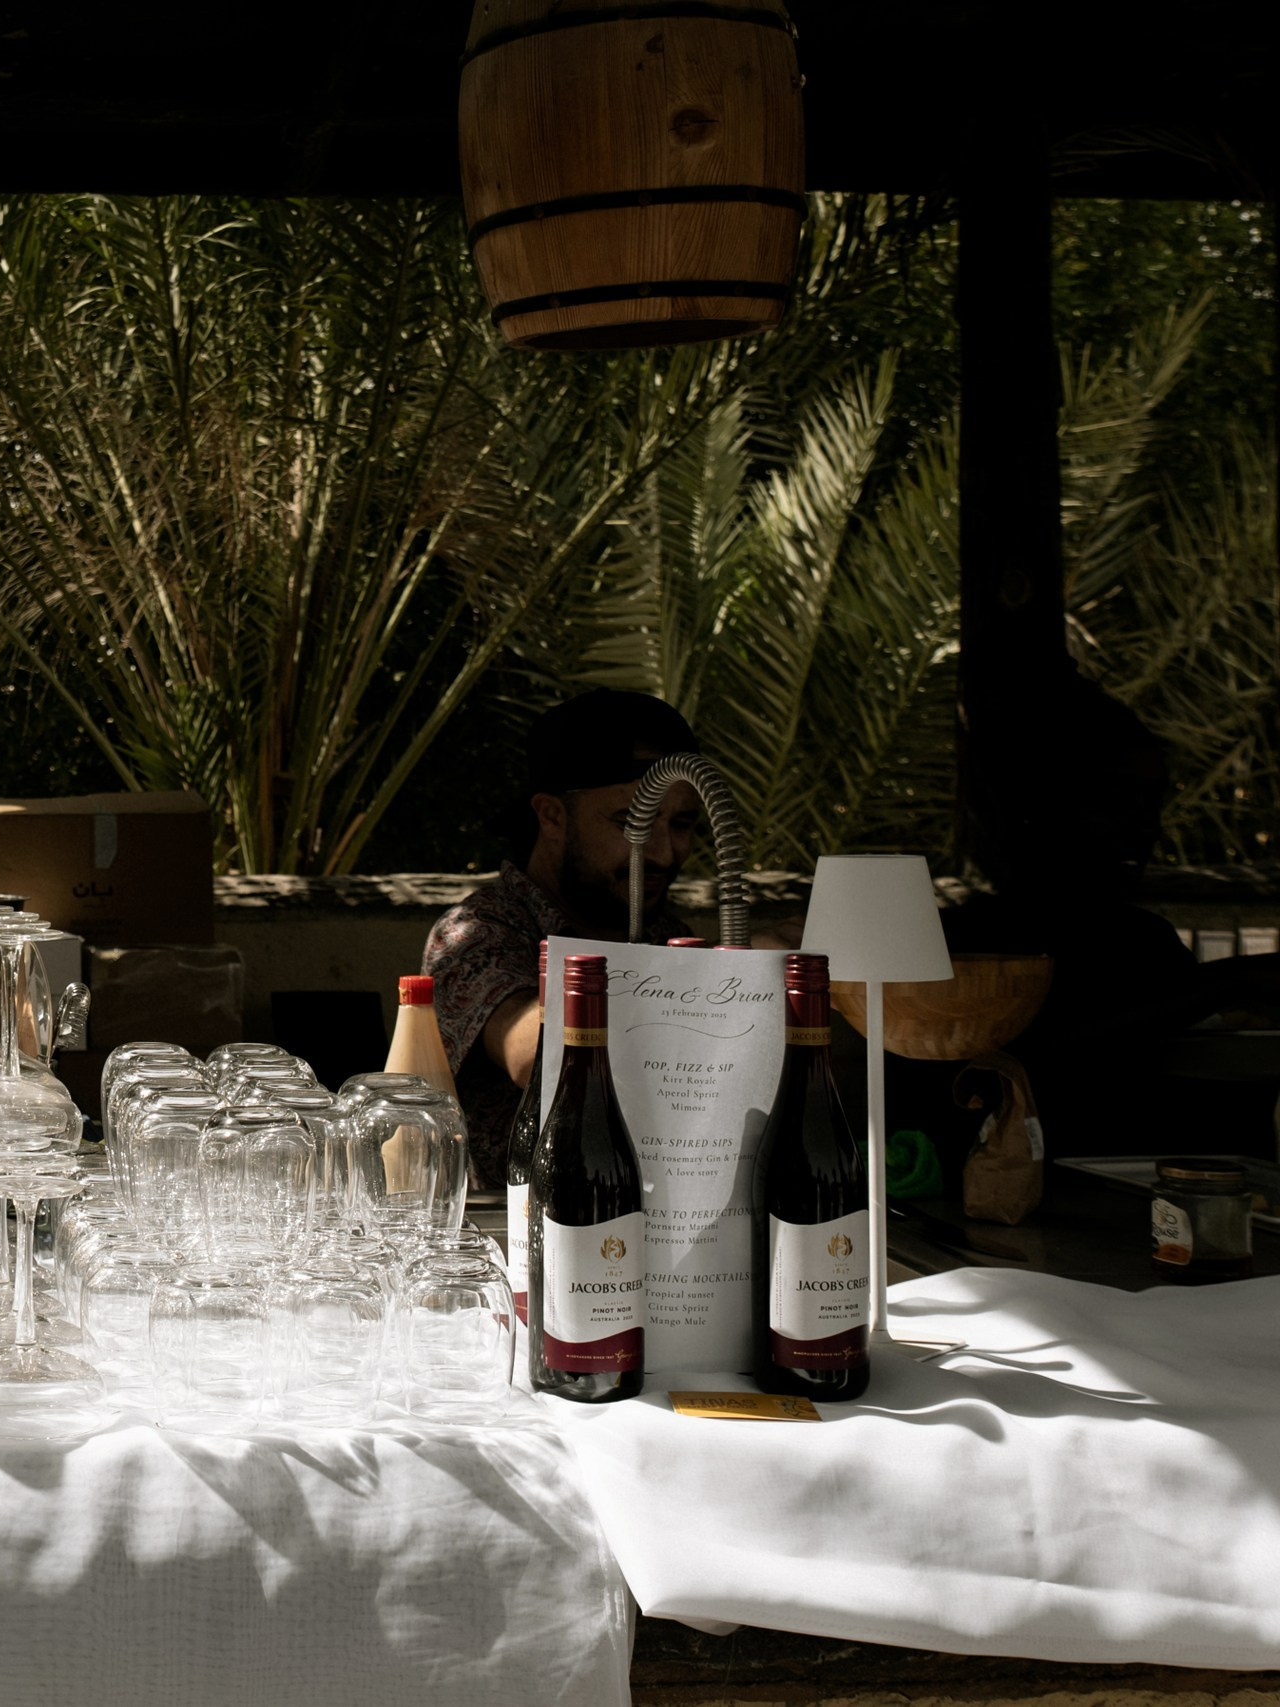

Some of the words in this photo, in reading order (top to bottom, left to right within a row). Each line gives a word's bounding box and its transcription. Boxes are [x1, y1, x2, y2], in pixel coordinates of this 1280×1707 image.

[608, 970, 678, 999] Elena
[680, 987, 701, 1003] &
[706, 976, 774, 1005] Brian
[672, 1009, 708, 1019] February
[643, 1060, 670, 1072] POP,
[676, 1062, 702, 1073] FIZZ
[718, 1063, 734, 1073] SIP
[687, 1076, 717, 1087] Royale
[657, 1088, 690, 1099] Aperol
[693, 1091, 720, 1101] Spritz
[671, 1102, 707, 1112] Mimosa
[641, 1136, 709, 1148] GIN-SPIRED
[712, 1138, 733, 1148] SIPS
[662, 1154, 702, 1165] rosemary
[706, 1154, 721, 1162] Gin
[665, 1168, 673, 1177] A
[676, 1168, 695, 1177] love
[673, 1210, 688, 1220] TO
[645, 1220, 686, 1231] Pornstar
[644, 1234, 685, 1245] Espresso
[688, 1236, 718, 1245] Martini
[693, 1271, 751, 1284] MOCKTAILS
[569, 1281, 617, 1294] JACOB'S
[796, 1279, 844, 1292] JACOB'S
[645, 1288, 684, 1299] Tropical
[688, 1291, 714, 1299] sunset
[648, 1302, 678, 1312] Citrus
[682, 1304, 709, 1314] Spritz
[650, 1316, 680, 1327] Mango
[684, 1317, 706, 1326] Mule
